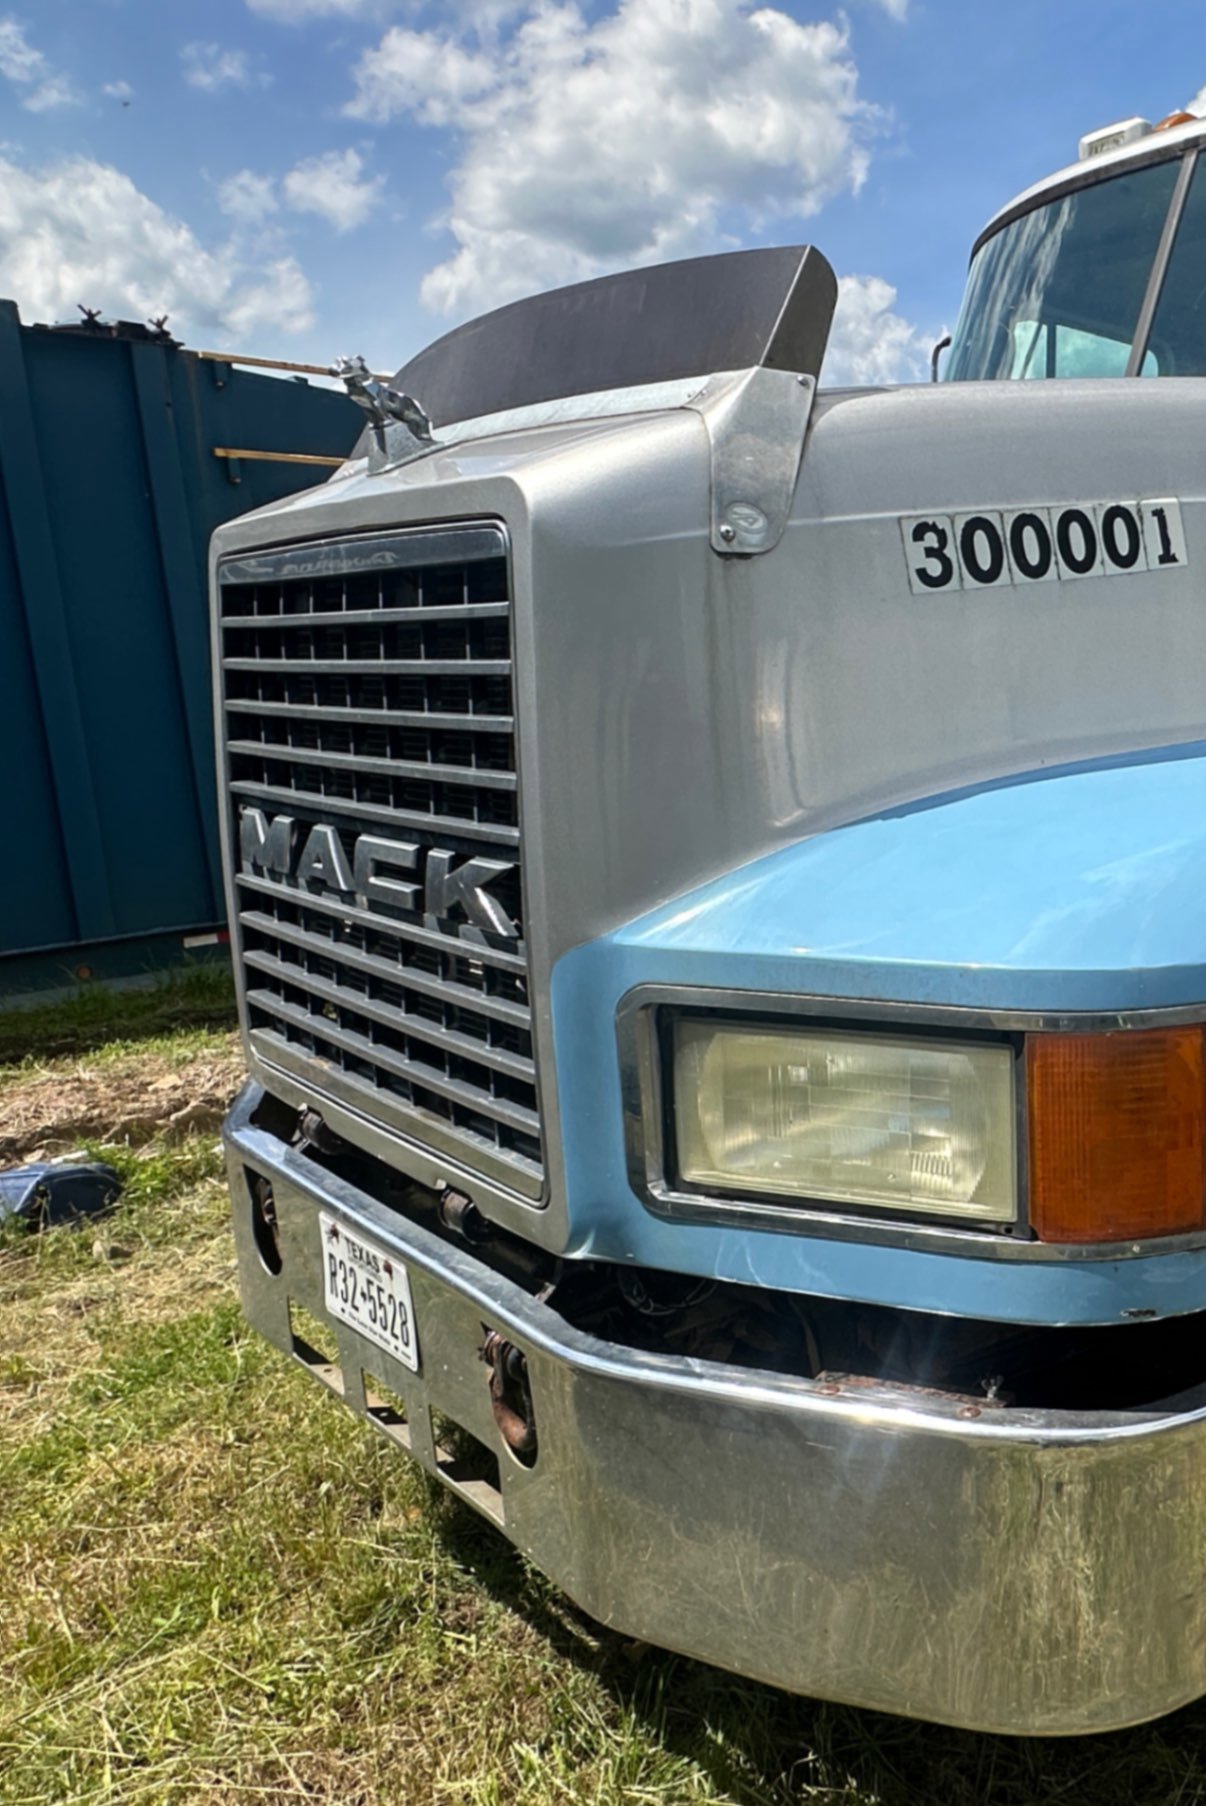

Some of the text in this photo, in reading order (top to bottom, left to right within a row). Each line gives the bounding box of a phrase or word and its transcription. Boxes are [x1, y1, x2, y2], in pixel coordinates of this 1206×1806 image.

[911, 504, 1180, 590] 300001
[239, 805, 520, 938] MACK
[343, 1235, 381, 1275] TEXAS
